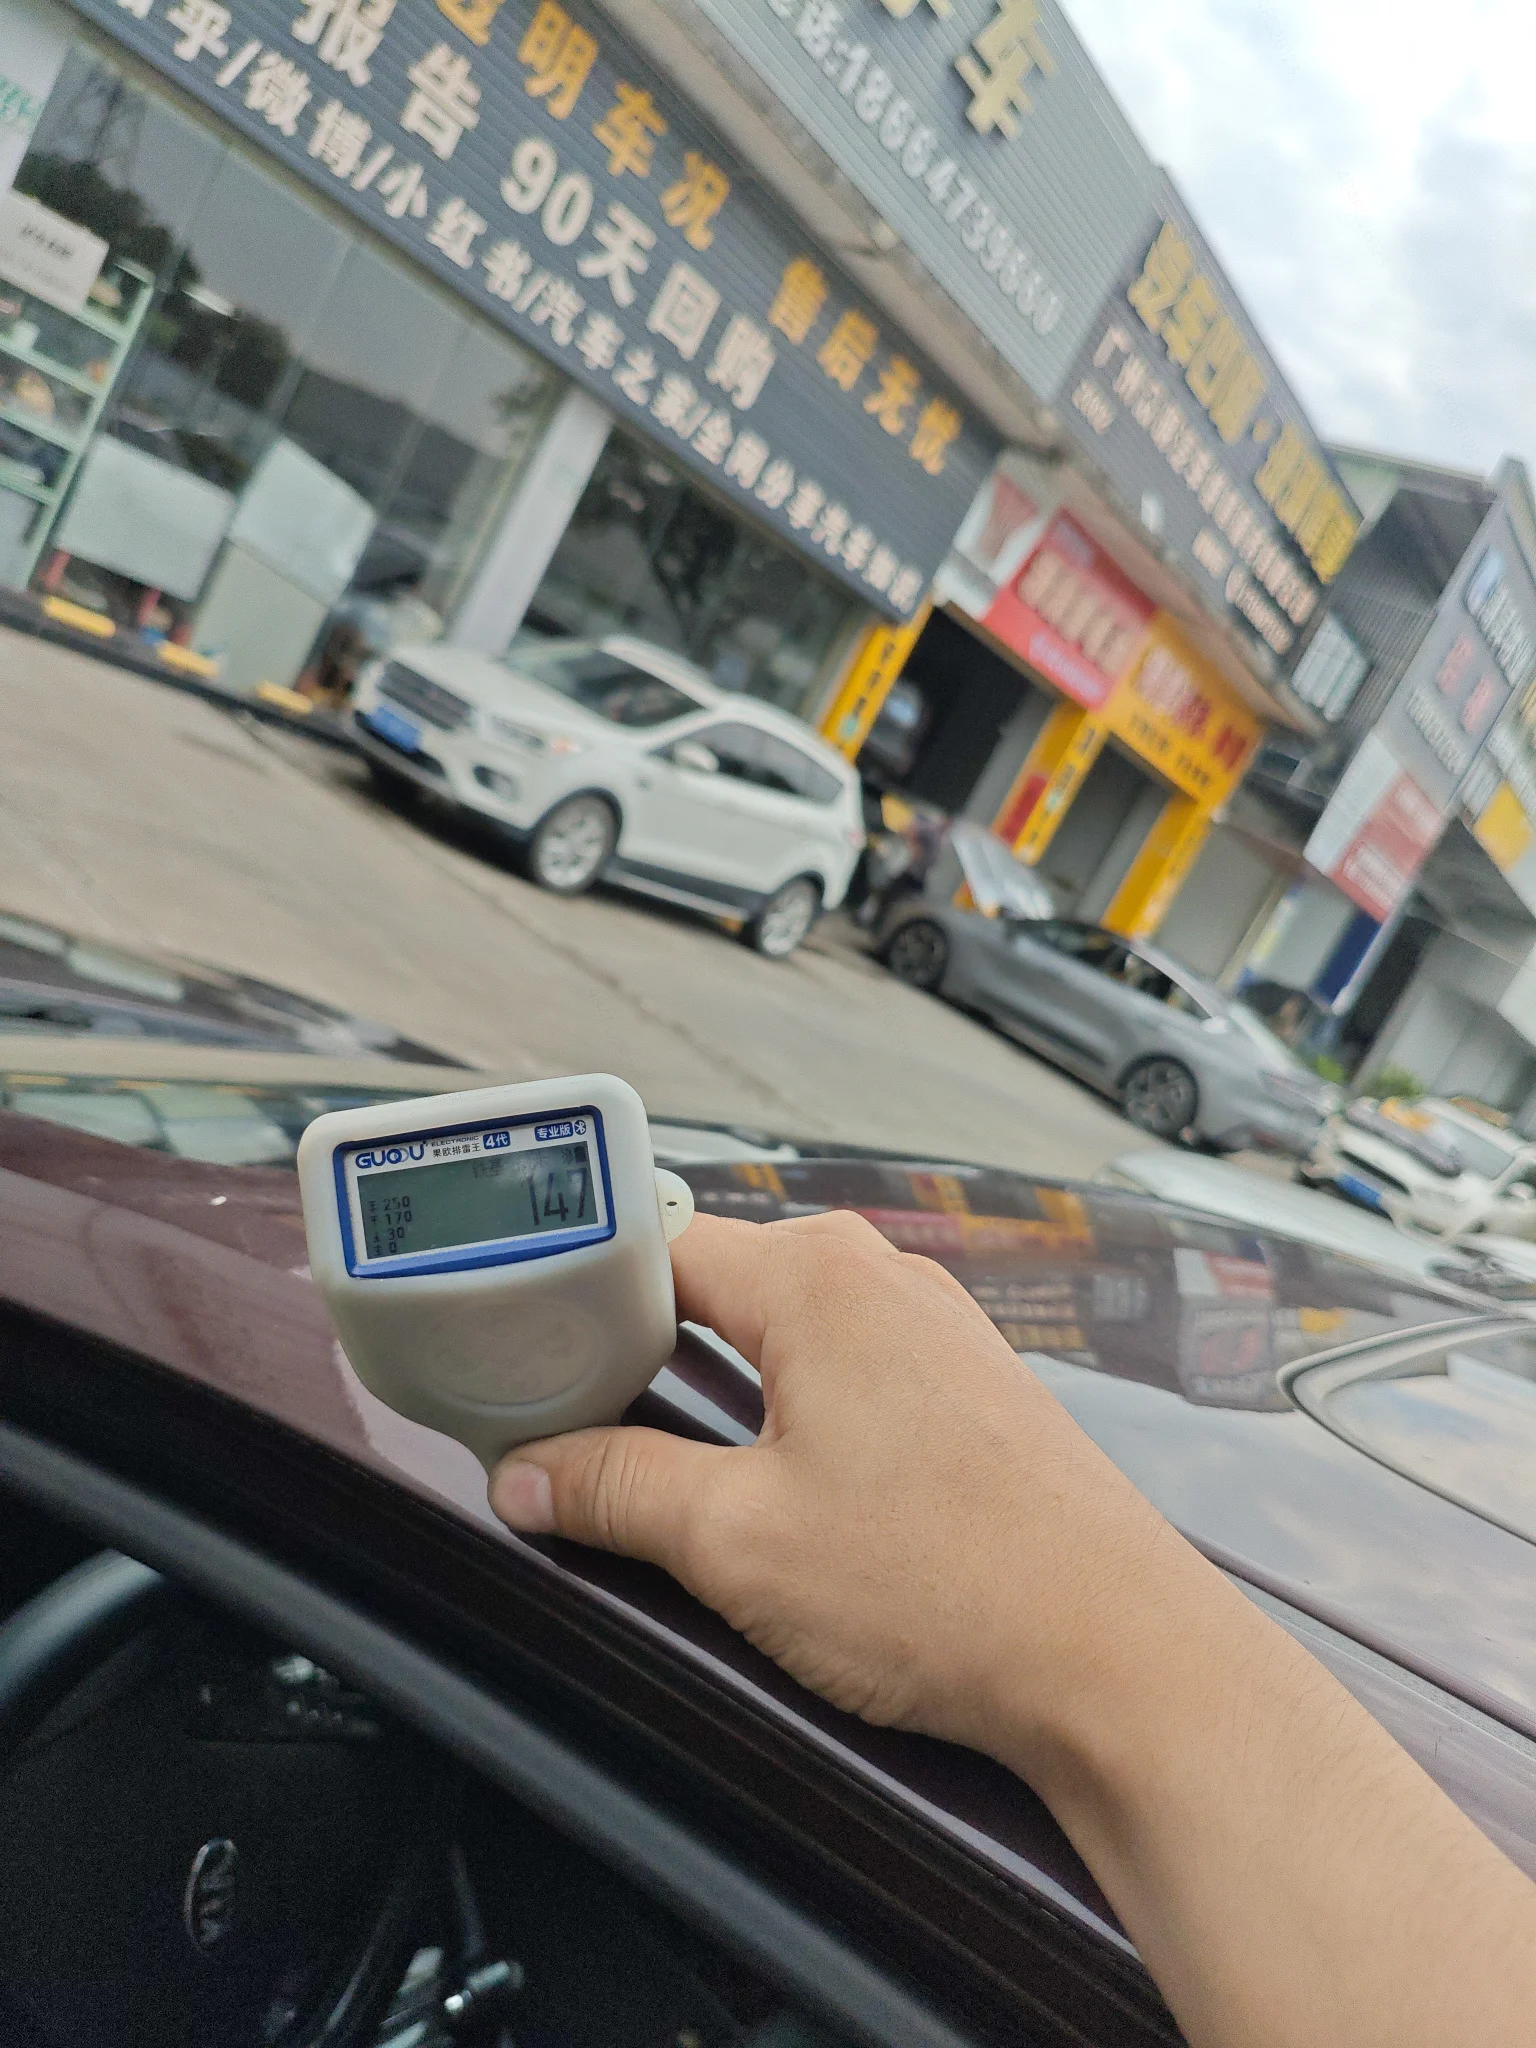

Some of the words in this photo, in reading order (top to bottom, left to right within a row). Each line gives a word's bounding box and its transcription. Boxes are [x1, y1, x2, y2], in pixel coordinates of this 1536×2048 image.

[115, 0, 924, 613] 乎/微博/小红书/汽车之家/全网分享汽车
[767, 255, 962, 476] 售后无忧
[536, 1123, 572, 1140] 专业版
[431, 1135, 480, 1147] ELECTRONIC
[485, 1132, 509, 1149] 4代
[432, 1142, 482, 1158] 果欧排雷王
[383, 1195, 411, 1212] 250
[527, 1167, 587, 1226] 147
[385, 1210, 413, 1225] 170
[388, 1227, 406, 1241] 30
